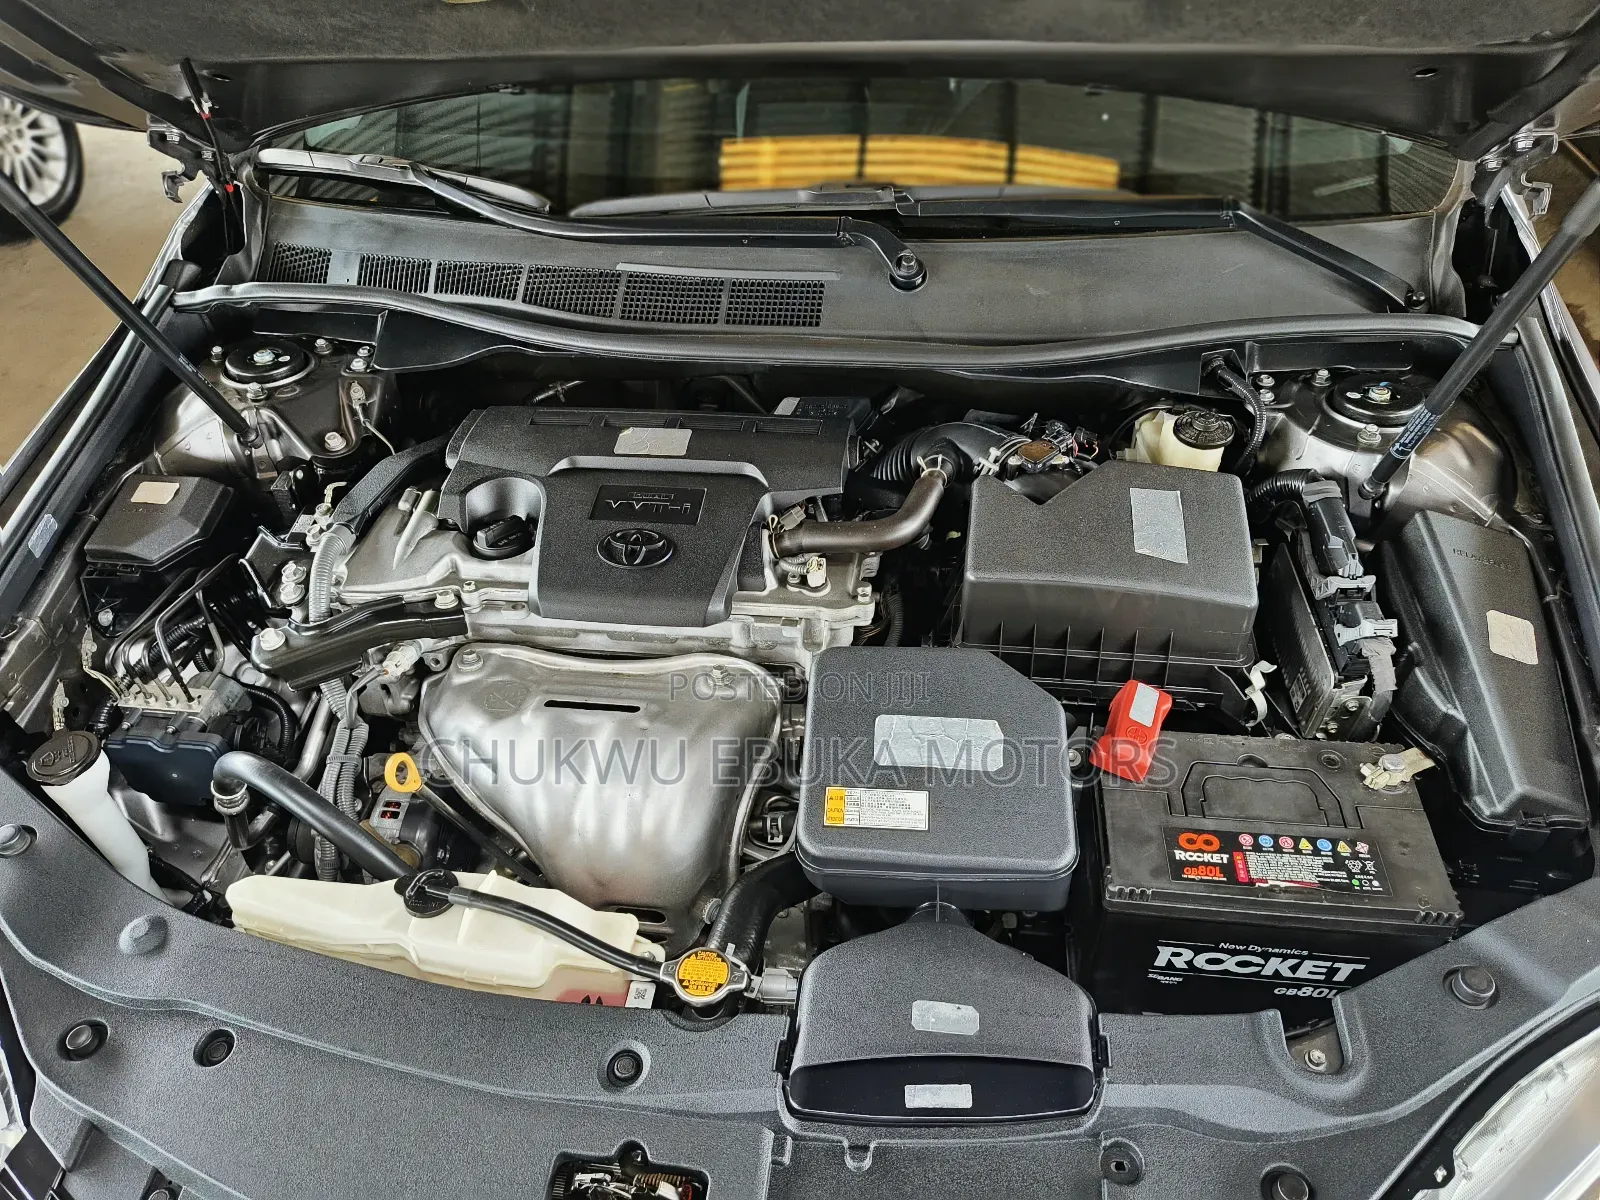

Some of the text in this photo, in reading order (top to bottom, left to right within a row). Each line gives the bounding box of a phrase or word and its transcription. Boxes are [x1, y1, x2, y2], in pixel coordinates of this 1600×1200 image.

[1173, 849, 1230, 864] ROCKET
[1183, 865, 1224, 878] GB80L
[1218, 942, 1309, 956] New Dynamics
[1153, 945, 1367, 982] ROCKET
[1273, 986, 1339, 999] GB80L
